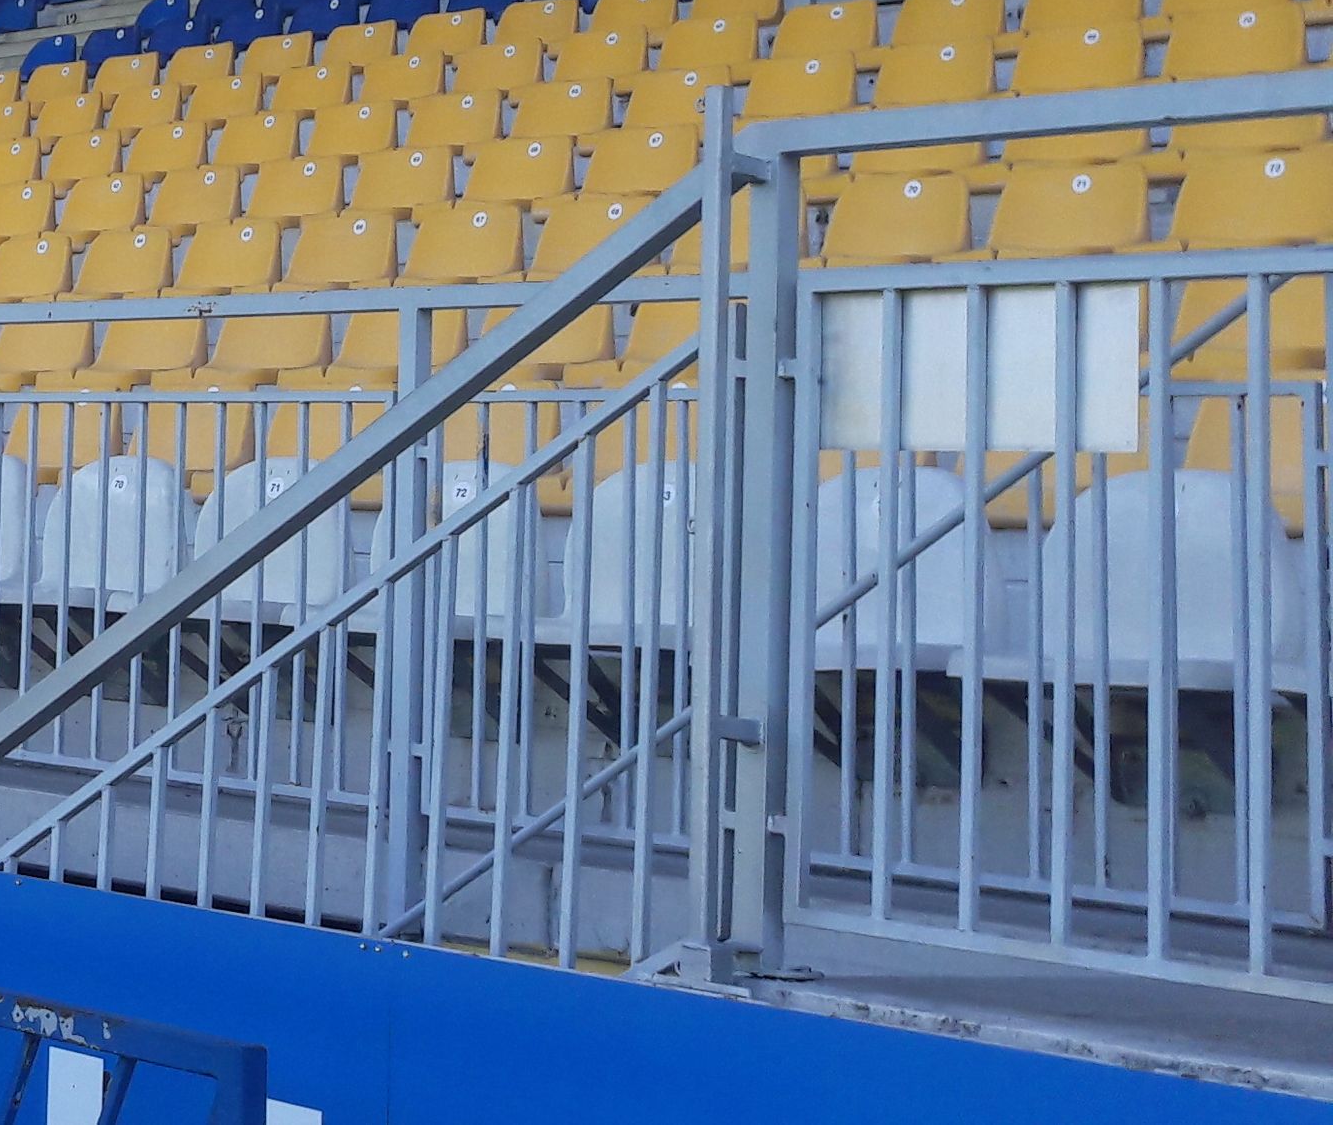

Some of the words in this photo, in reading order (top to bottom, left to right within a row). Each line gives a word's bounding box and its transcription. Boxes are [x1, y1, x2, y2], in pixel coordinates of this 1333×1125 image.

[113, 479, 125, 489] 70
[269, 481, 281, 492] 71
[455, 487, 468, 498] 72
[662, 490, 671, 501] 3
